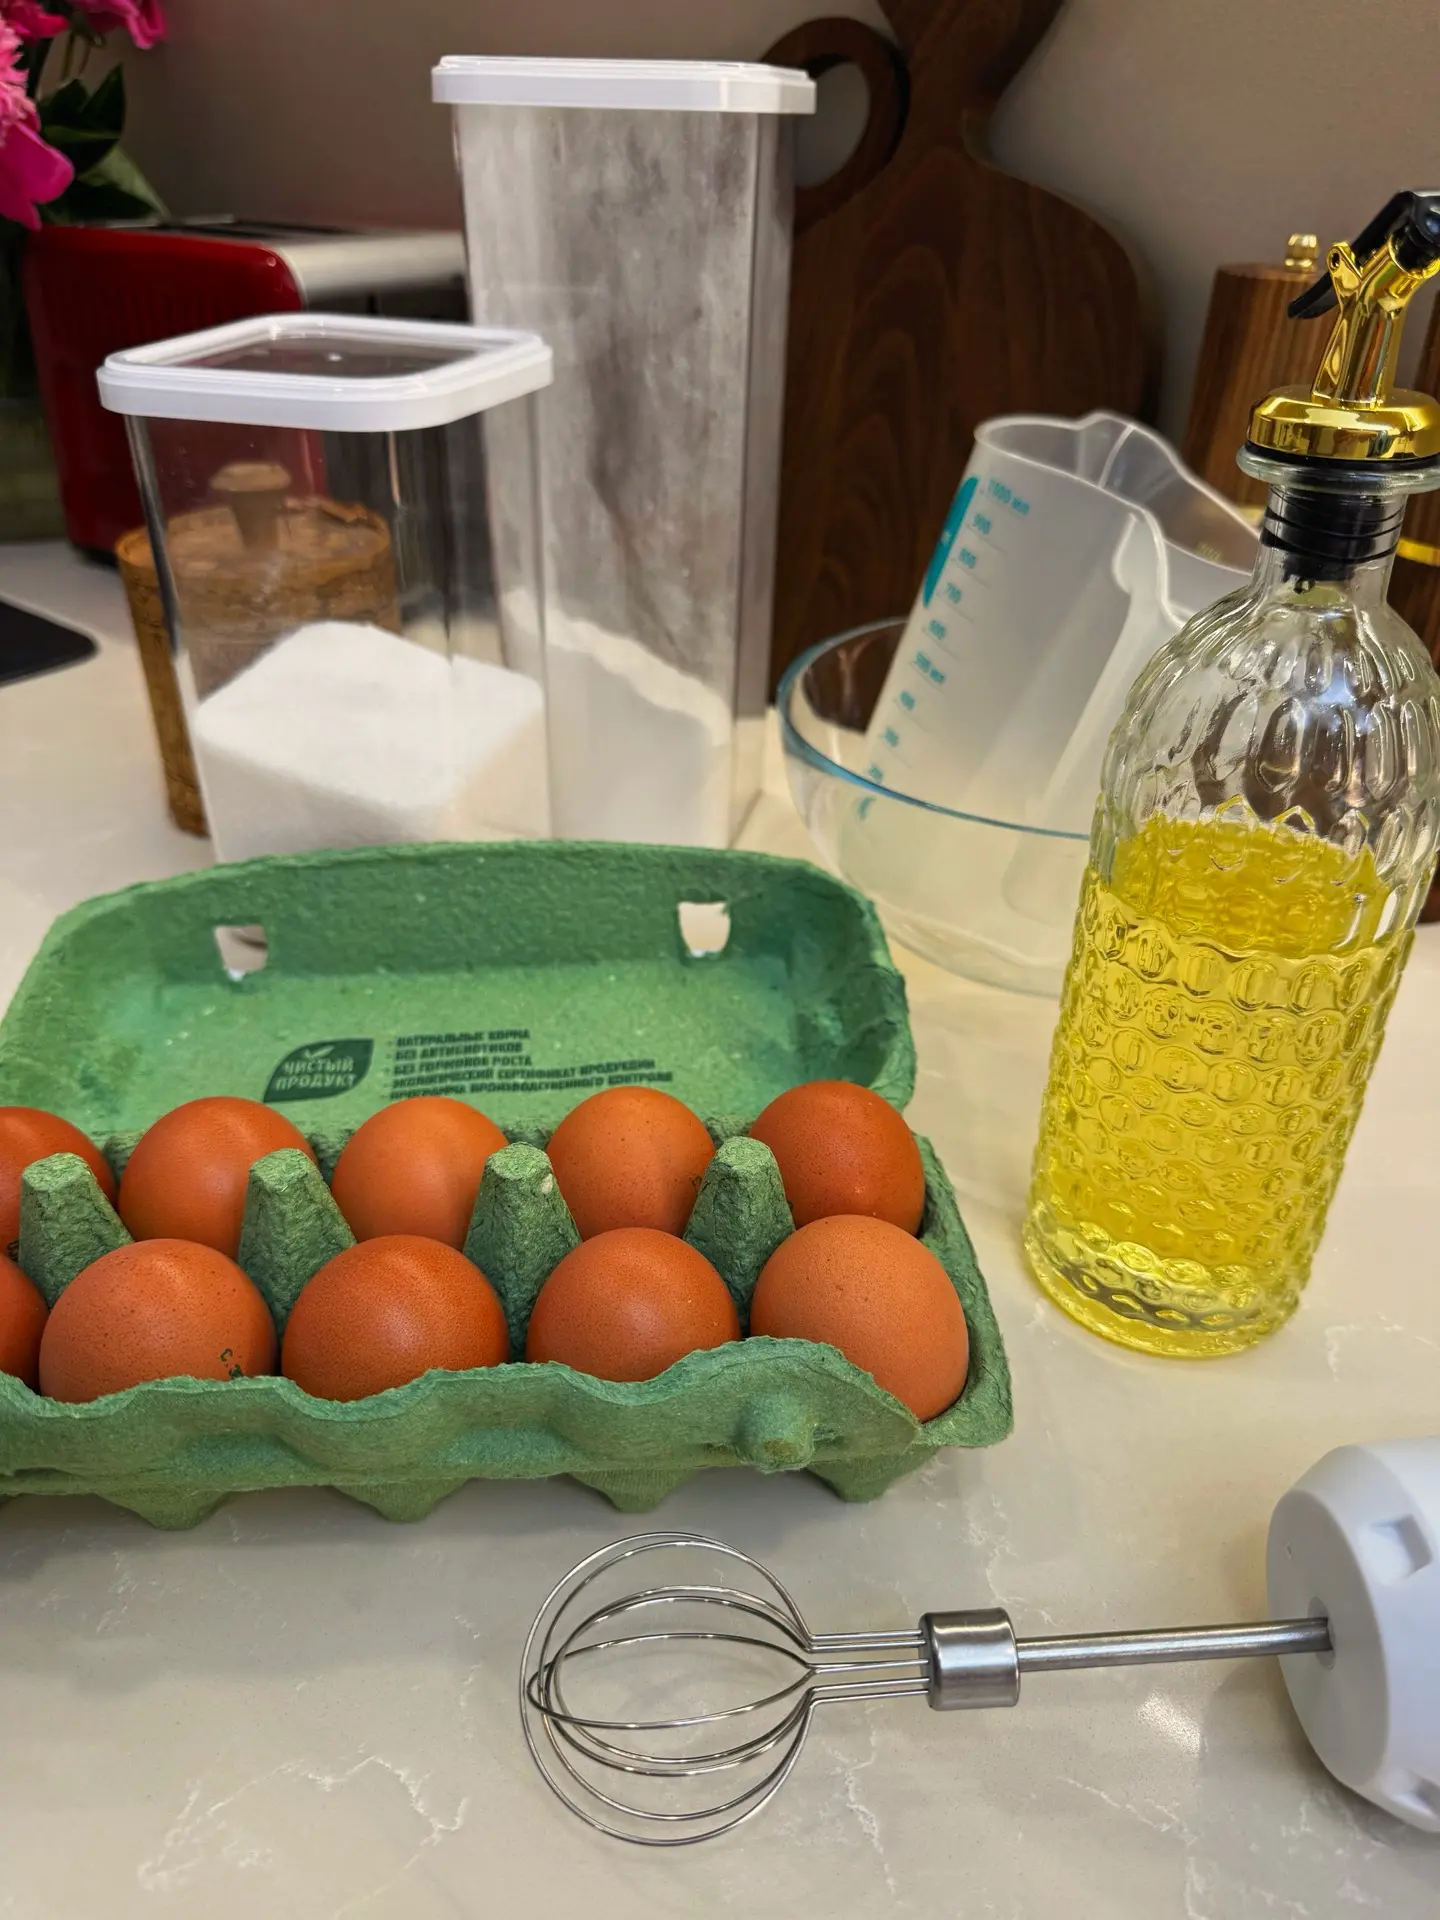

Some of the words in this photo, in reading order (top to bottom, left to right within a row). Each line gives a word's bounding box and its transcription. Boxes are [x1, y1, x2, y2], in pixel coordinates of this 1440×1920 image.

[488, 1029, 530, 1040] КОРМА
[396, 1048, 417, 1060] БЕЗ
[420, 1042, 522, 1058] АНТИБИОТИКОВ
[284, 1056, 354, 1074] ЧИСТЫЙ
[394, 1063, 415, 1075] БЕЗ
[418, 1056, 489, 1071] ГОРМОНОВ
[492, 1056, 532, 1066] РОСТА
[498, 1066, 575, 1080] СЕРТИФИКАТ
[276, 1074, 357, 1091] ПРОДУКТ
